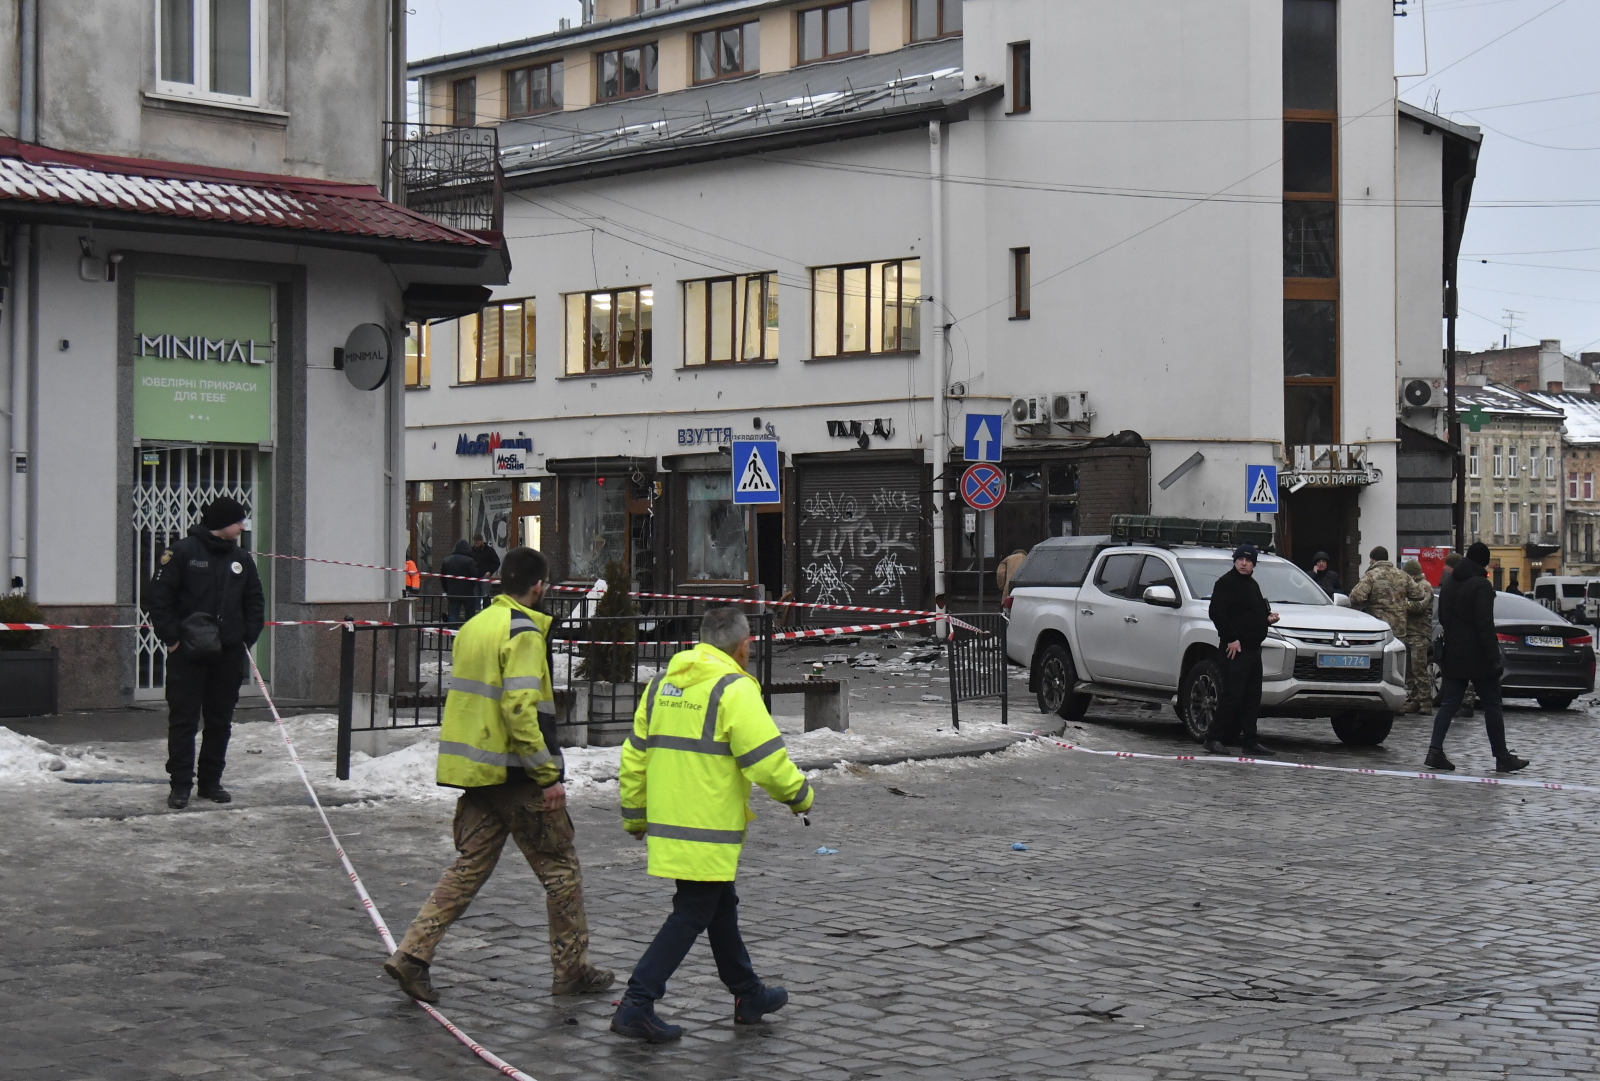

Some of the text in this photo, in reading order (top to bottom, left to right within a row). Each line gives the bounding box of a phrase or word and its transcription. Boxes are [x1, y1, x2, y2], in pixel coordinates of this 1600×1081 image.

[140, 333, 265, 364] MINIMAL
[345, 350, 385, 363] MINIMAL
[142, 377, 257, 392] ЮВЕЛІРНІ ПРИКРАСИ
[174, 391, 226, 403] ДЛЯ ТЕБЕ
[677, 427, 732, 445] ВЗУТТЯ
[1529, 636, 1538, 644] BC
[1343, 656, 1364, 666] 1774
[659, 699, 702, 710] Test and Trace
